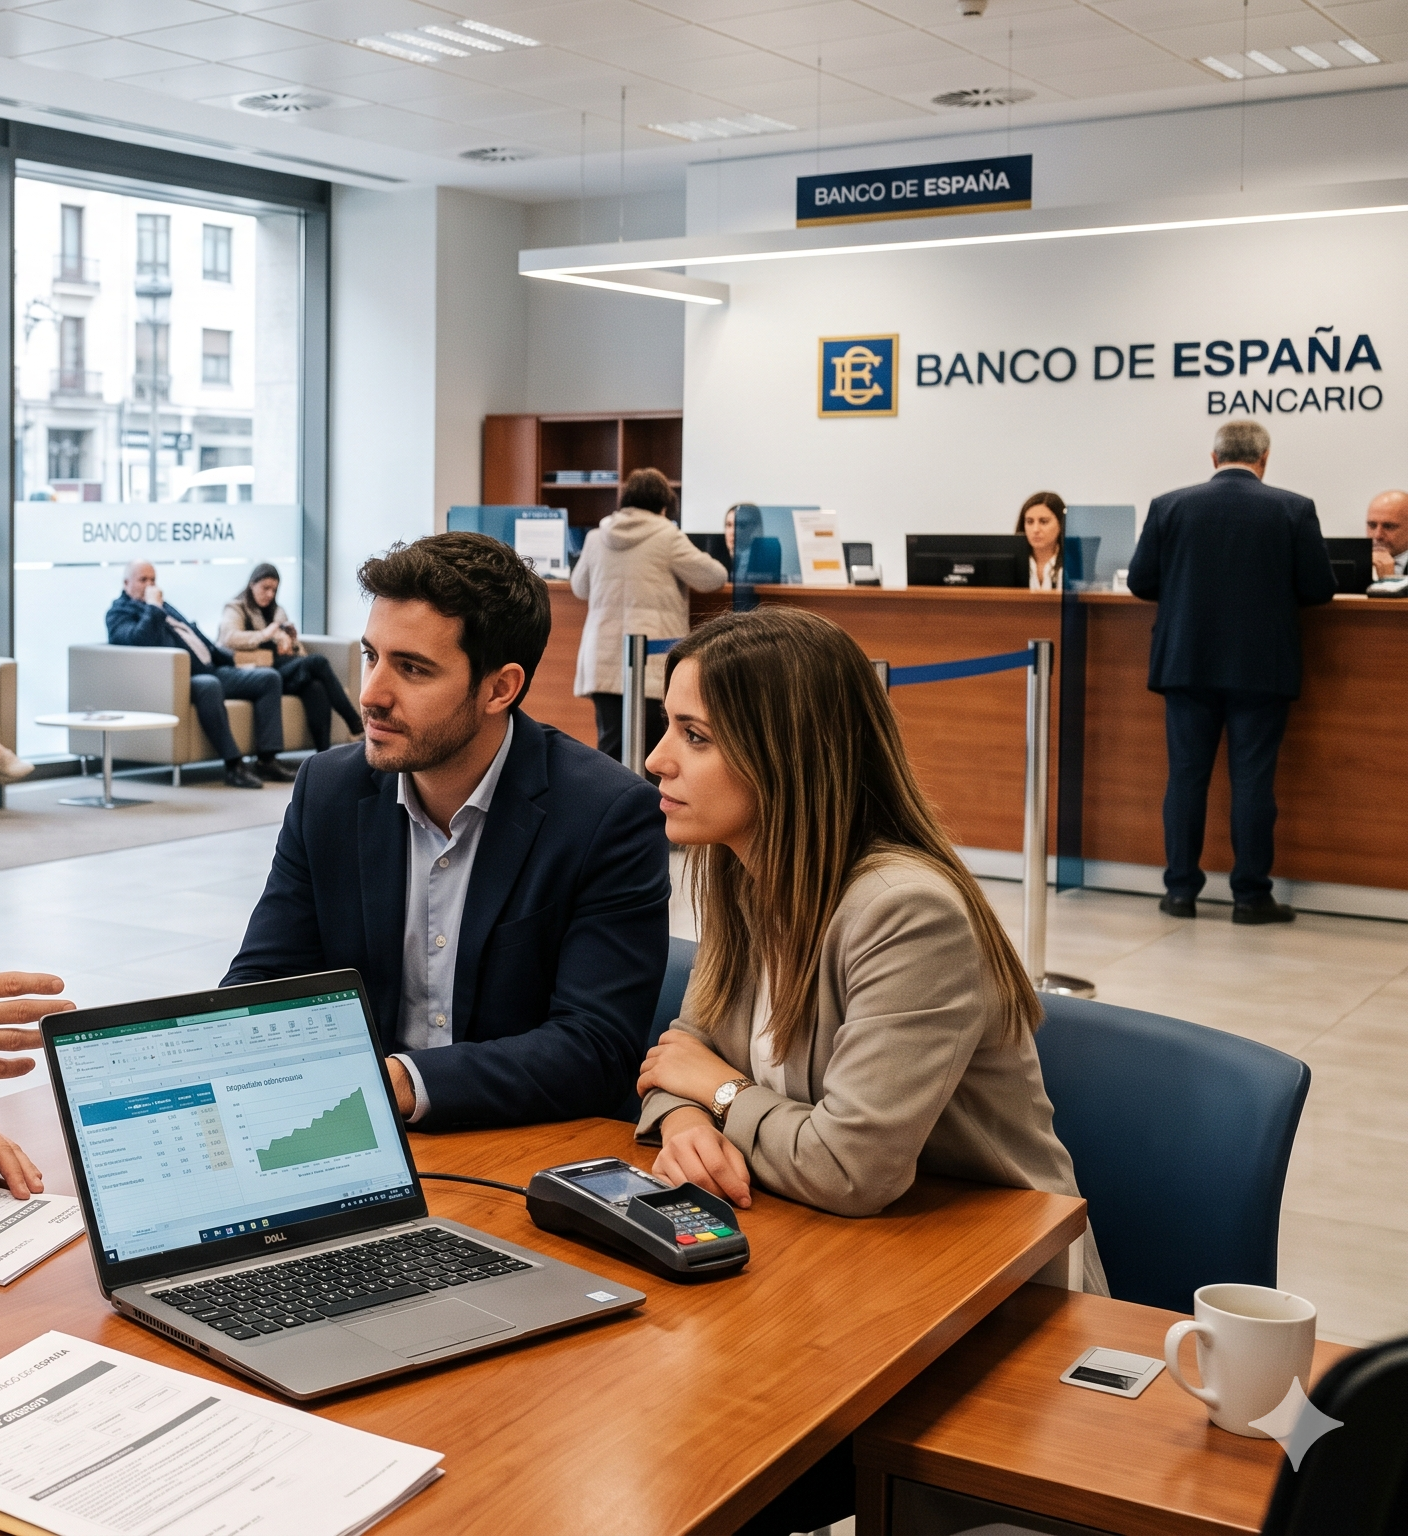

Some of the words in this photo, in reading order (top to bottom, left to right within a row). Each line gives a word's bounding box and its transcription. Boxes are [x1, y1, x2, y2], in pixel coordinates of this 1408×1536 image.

[814, 182, 886, 206] BANCO
[891, 179, 919, 199] DE
[923, 168, 1011, 197] ESPAÑA
[916, 346, 1078, 388] BANCO
[1093, 343, 1156, 382] DE
[1172, 325, 1383, 378] ESPAÑA
[1206, 384, 1384, 416] BANCARIO
[82, 521, 142, 543] BANCO
[146, 521, 168, 542] DE
[172, 518, 235, 542] ESPAÑA
